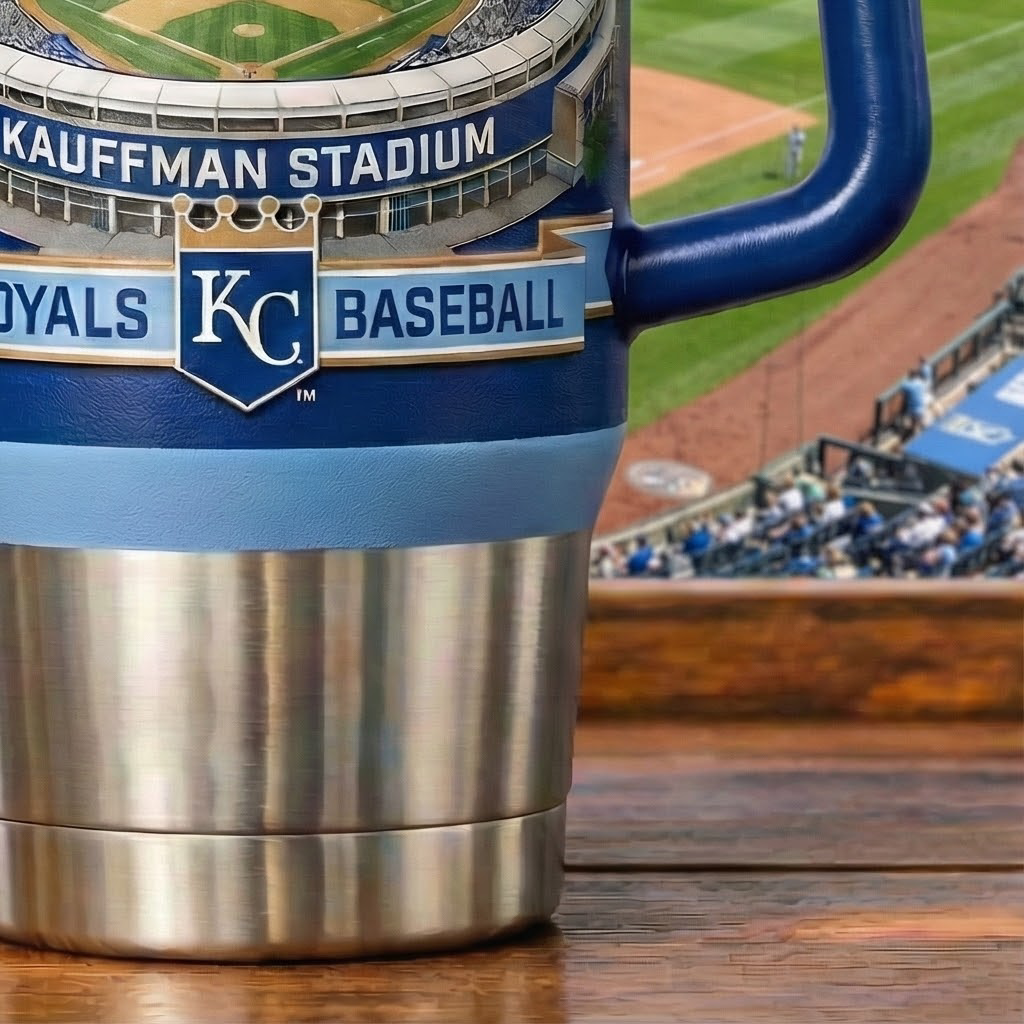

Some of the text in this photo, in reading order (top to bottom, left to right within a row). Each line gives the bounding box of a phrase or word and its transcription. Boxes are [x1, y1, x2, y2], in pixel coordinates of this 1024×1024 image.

[2, 116, 496, 190] KAUFFMAN STADIUM
[192, 269, 301, 366] KC
[335, 278, 564, 340] BASEBALL
